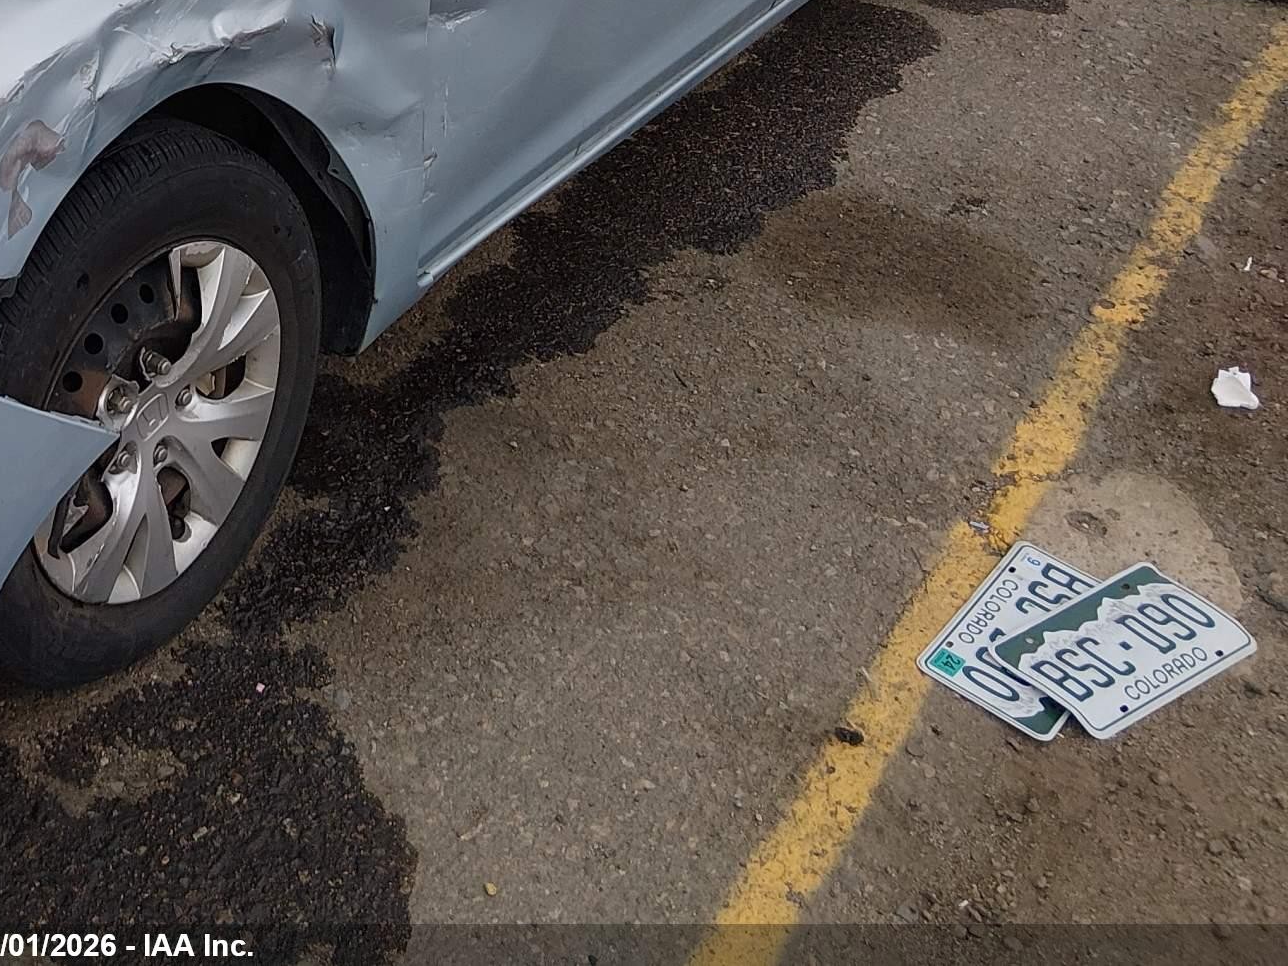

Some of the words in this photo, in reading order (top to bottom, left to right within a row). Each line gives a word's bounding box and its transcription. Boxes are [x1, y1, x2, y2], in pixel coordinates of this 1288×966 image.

[958, 579, 1018, 644] COLORADO
[942, 654, 961, 671] 24
[1124, 646, 1208, 701] COLORADO
